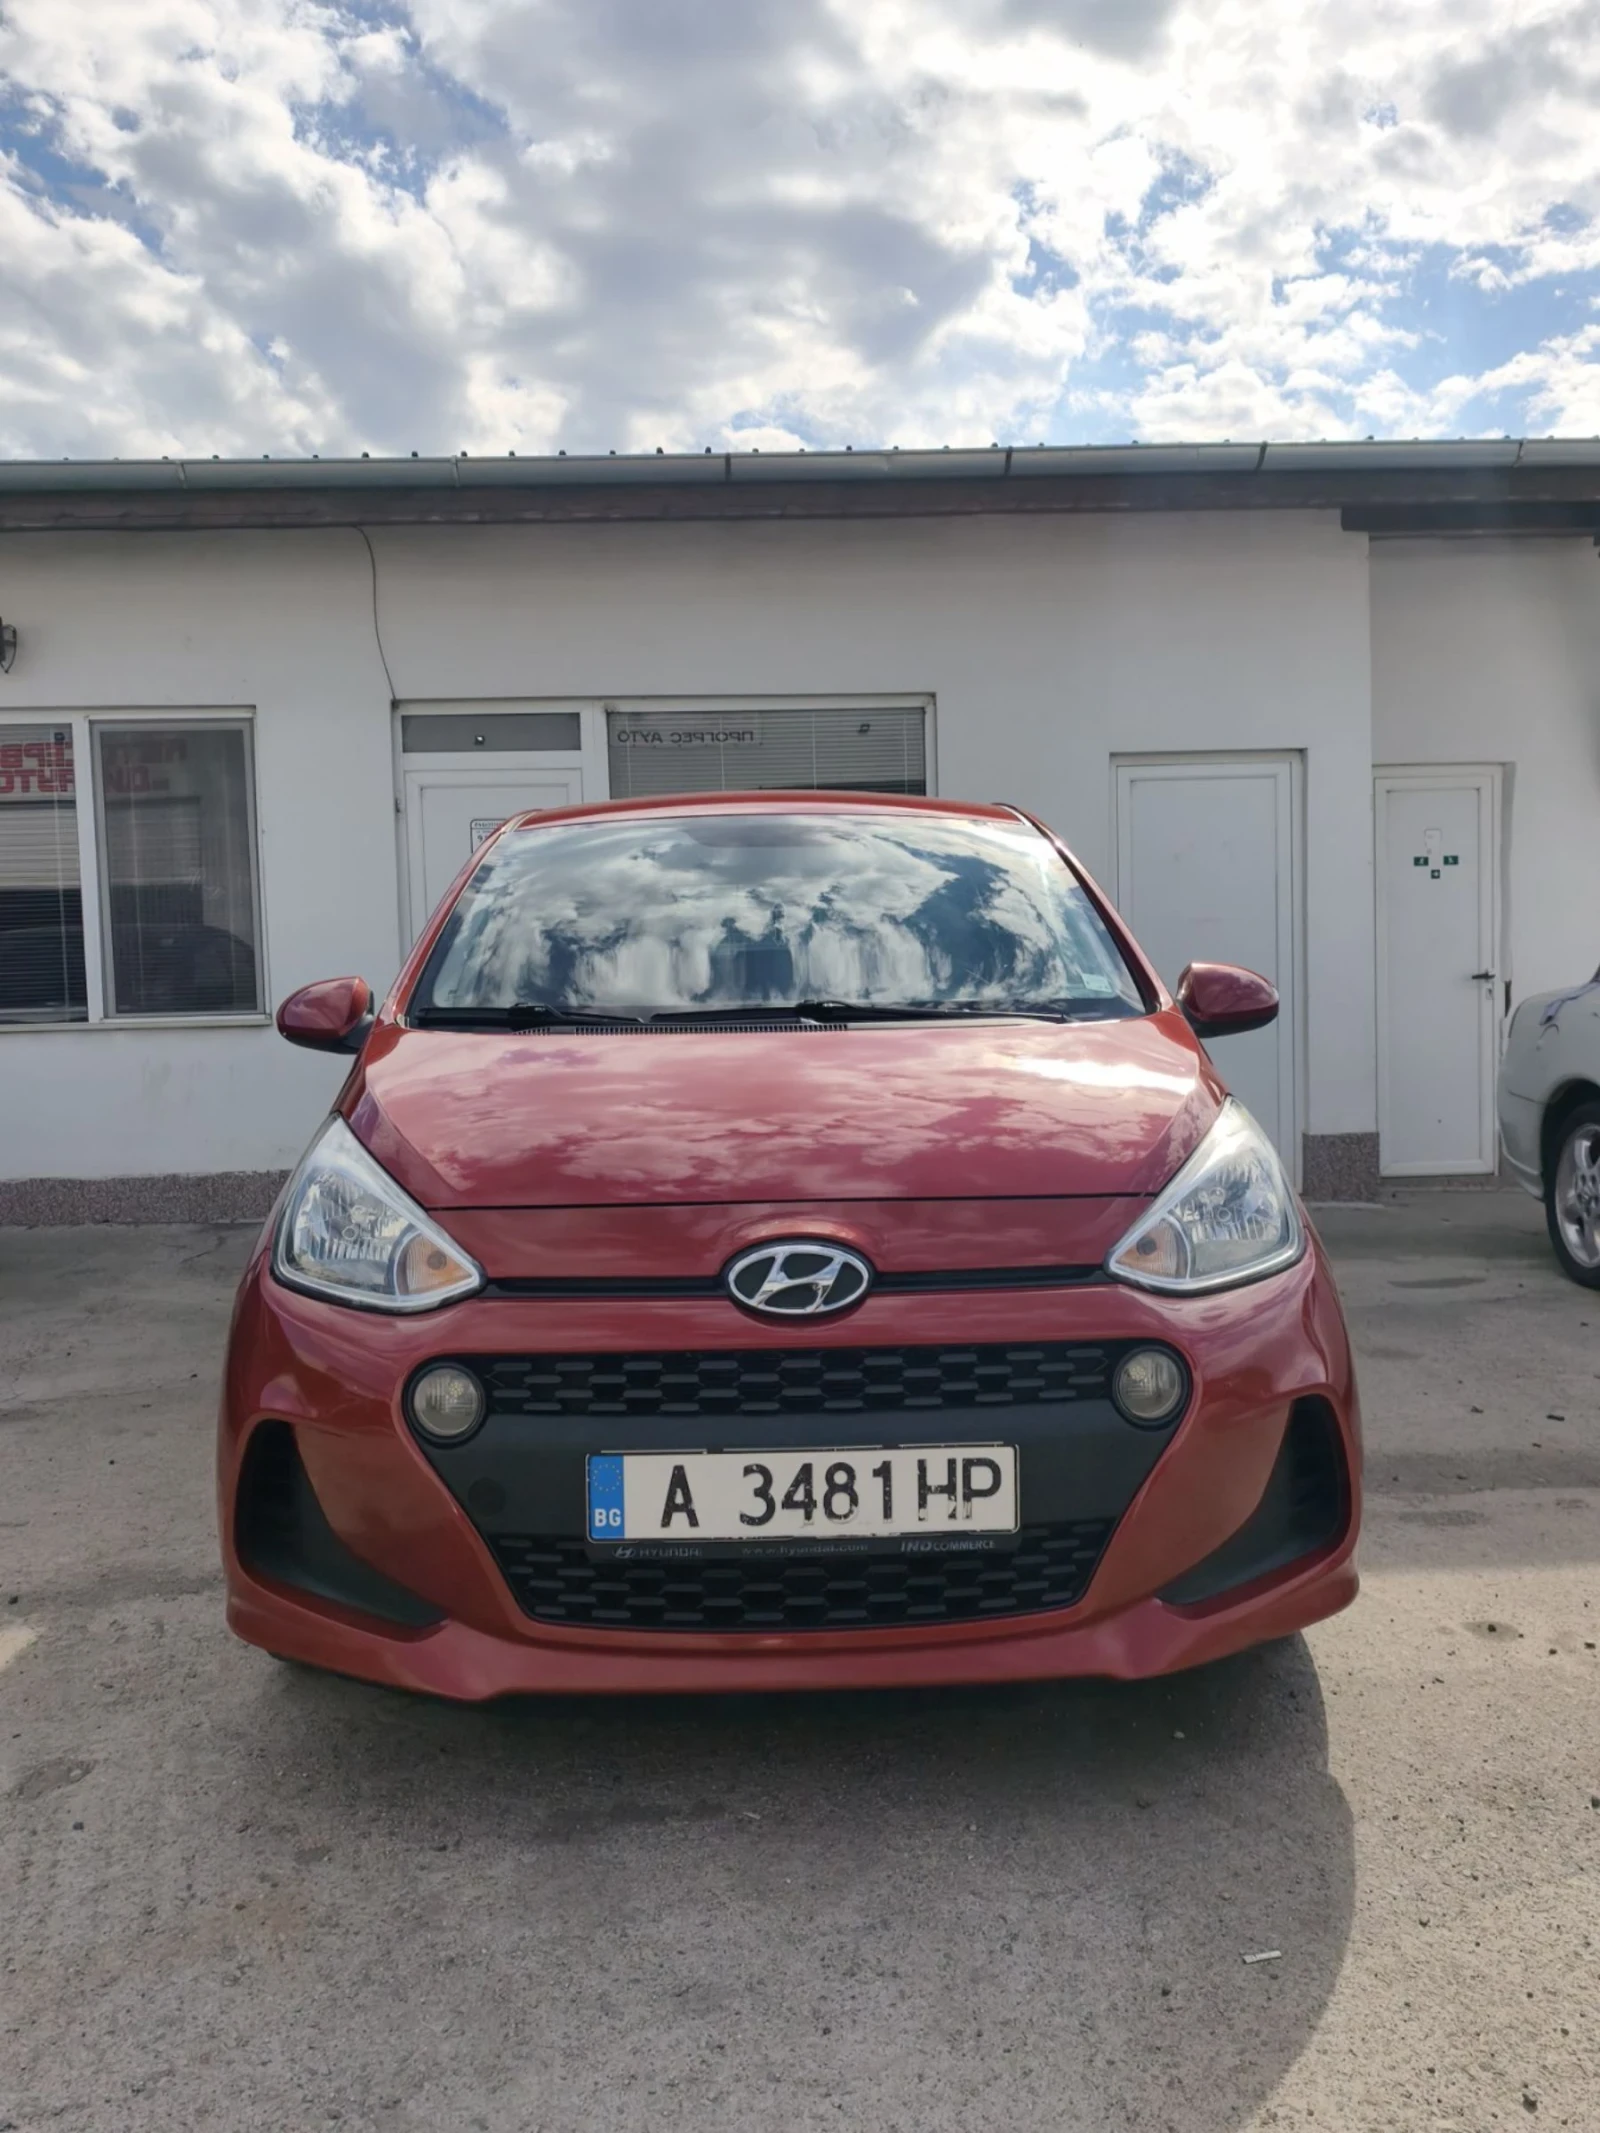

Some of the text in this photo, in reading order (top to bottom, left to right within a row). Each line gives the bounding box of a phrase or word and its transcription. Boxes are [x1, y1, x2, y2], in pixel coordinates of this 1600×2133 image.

[660, 1457, 1001, 1528] A 3481 HP
[594, 1508, 621, 1527] BG
